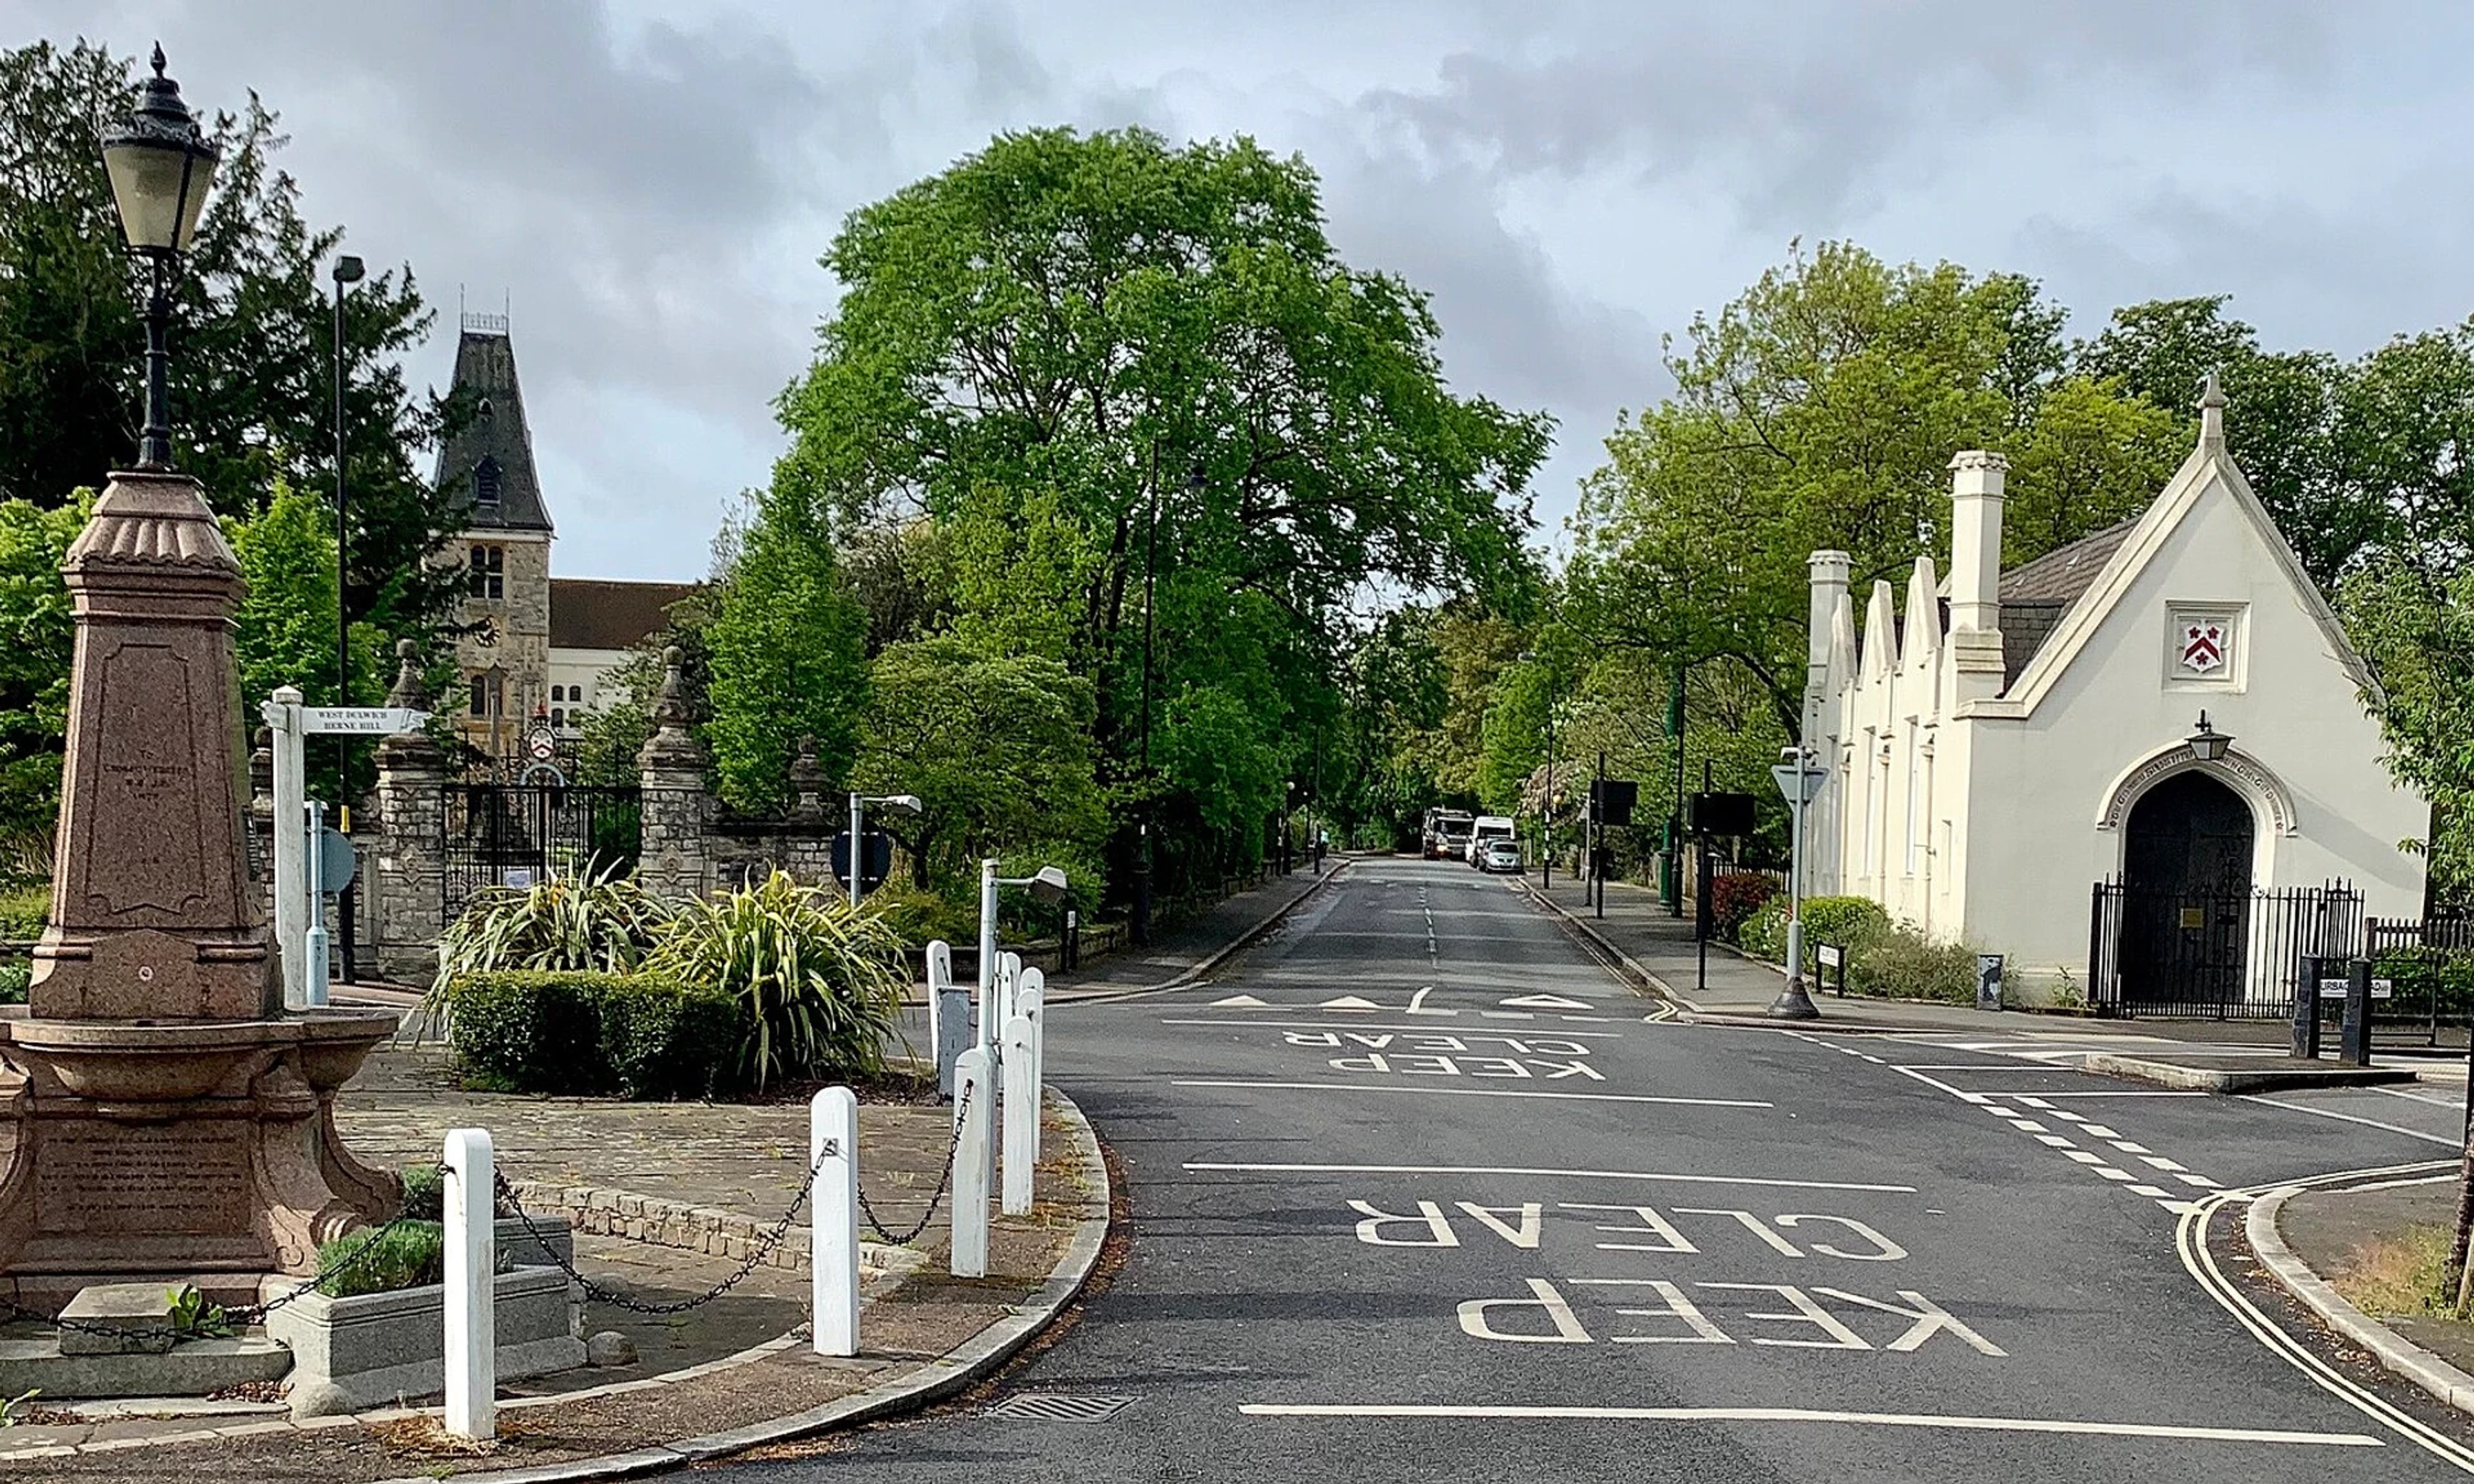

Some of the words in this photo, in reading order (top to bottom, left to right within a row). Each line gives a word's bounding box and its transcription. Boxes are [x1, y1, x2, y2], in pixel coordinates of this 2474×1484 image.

[1282, 1032, 1590, 1055] CLEAR
[1328, 1054, 1606, 1081] KEEP
[1347, 1199, 1910, 1260] CLEAR
[1457, 1279, 2009, 1356] KEEP
